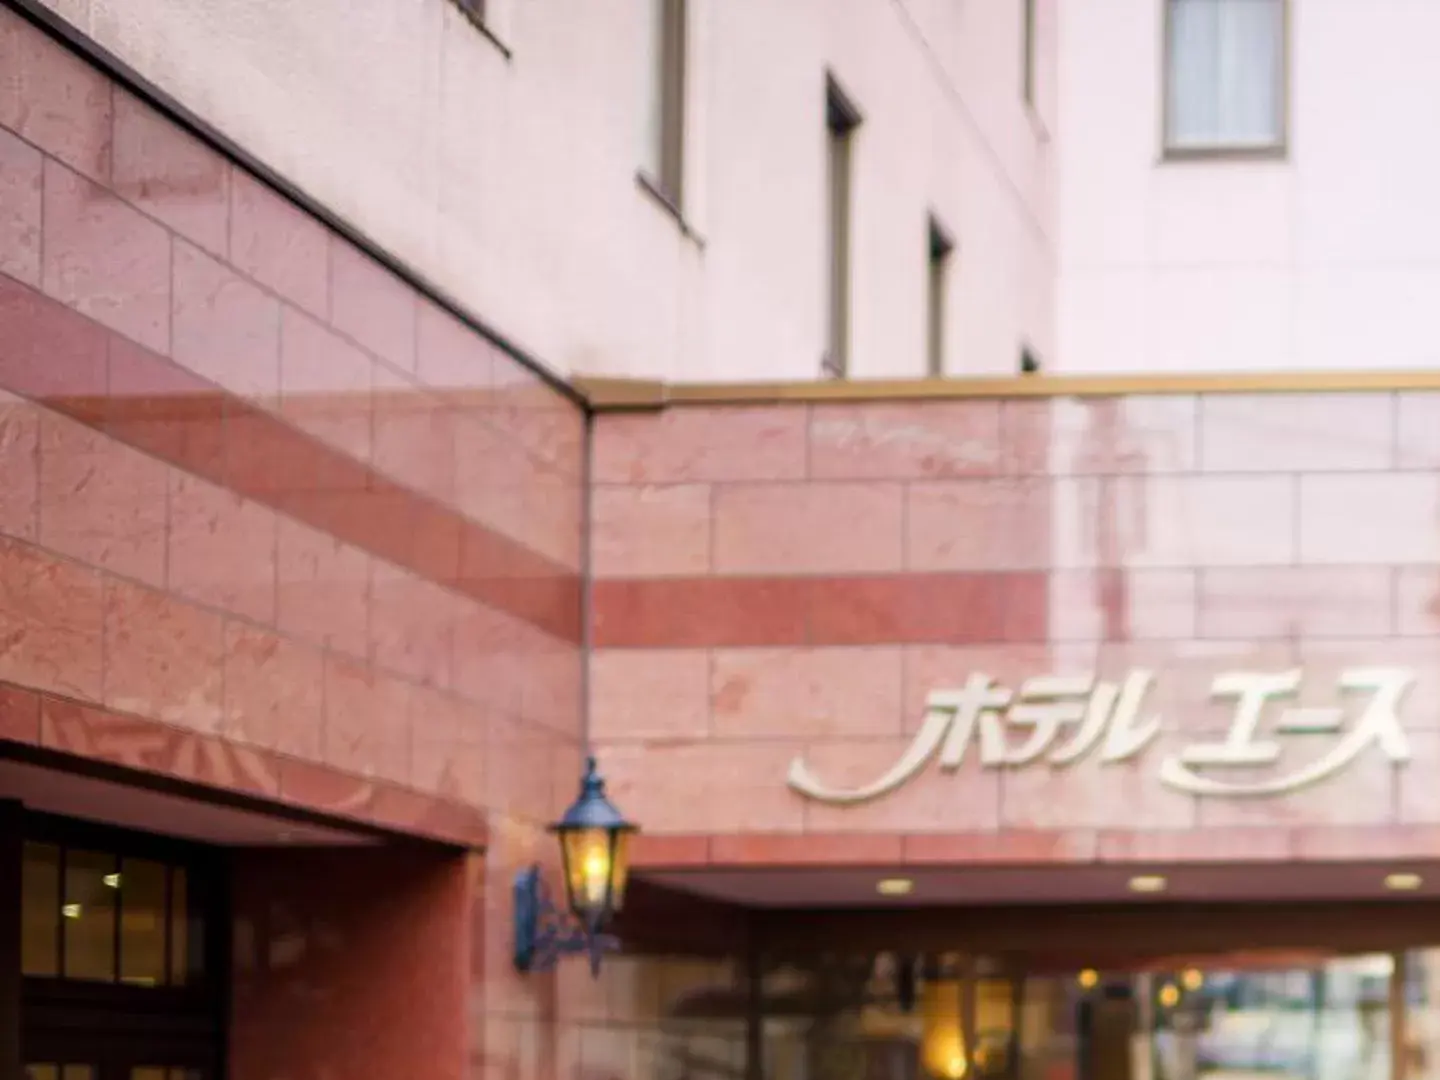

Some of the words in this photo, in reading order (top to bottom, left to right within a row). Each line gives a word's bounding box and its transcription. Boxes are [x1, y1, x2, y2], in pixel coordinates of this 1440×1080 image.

[787, 670, 1161, 801] ホテル
[1160, 667, 1413, 797] エース
